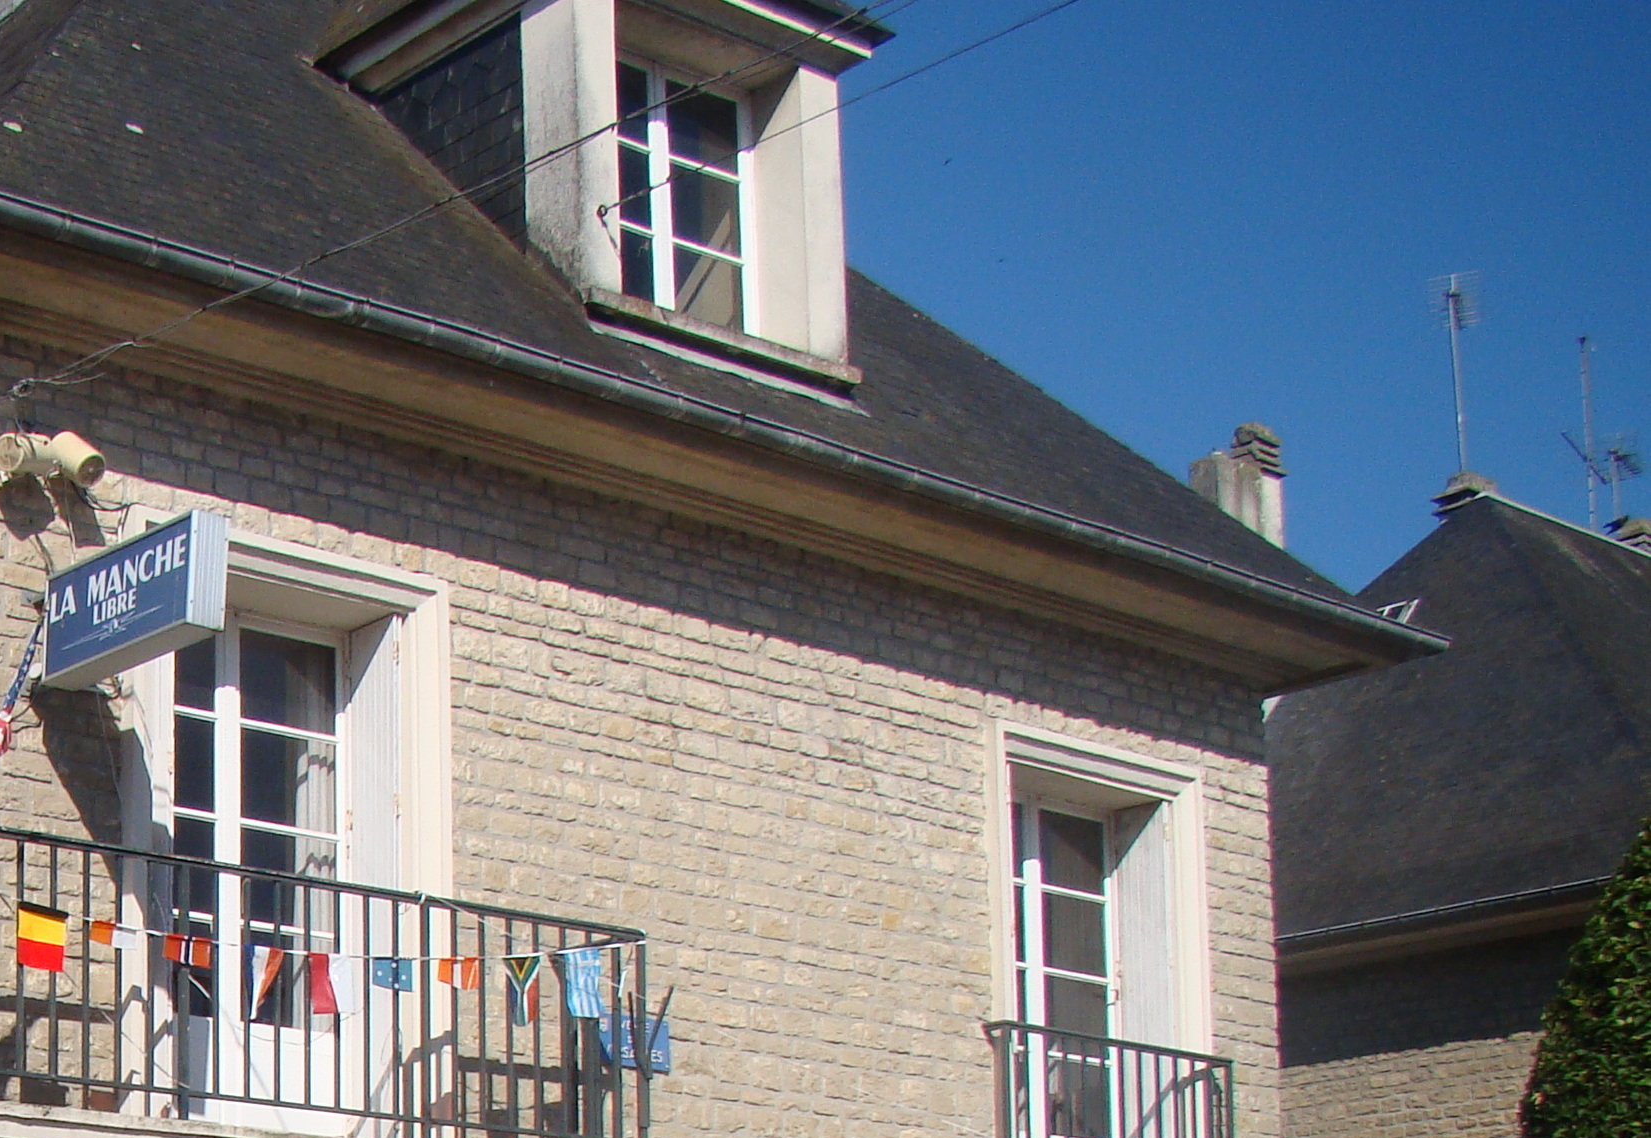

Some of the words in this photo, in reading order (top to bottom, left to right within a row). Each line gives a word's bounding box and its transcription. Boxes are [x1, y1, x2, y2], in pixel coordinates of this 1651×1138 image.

[50, 585, 77, 624] LA
[87, 533, 187, 607] MANCHE
[93, 588, 137, 625] LIBRE
